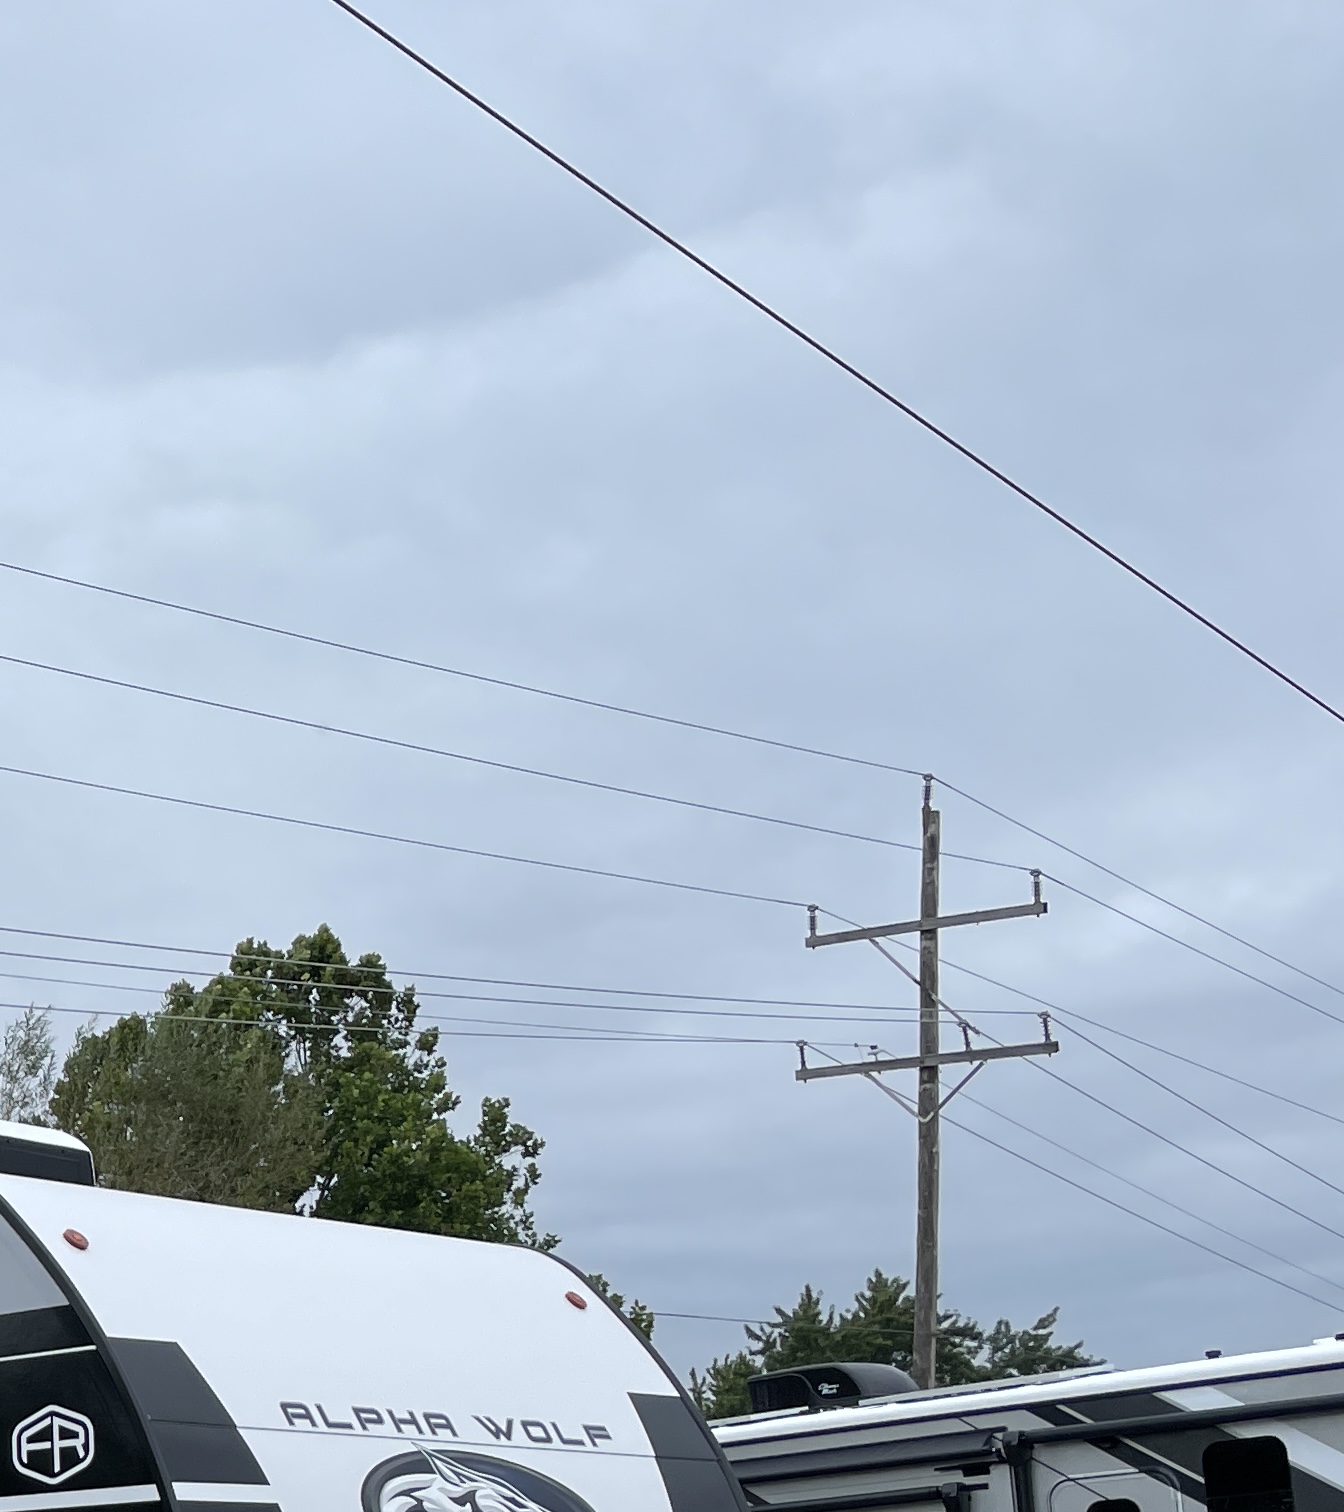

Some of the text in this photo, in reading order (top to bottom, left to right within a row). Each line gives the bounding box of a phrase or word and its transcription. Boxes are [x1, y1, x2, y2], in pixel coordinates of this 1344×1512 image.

[18, 1413, 87, 1475] FR
[279, 1400, 614, 1449] ALPHA WOLF
